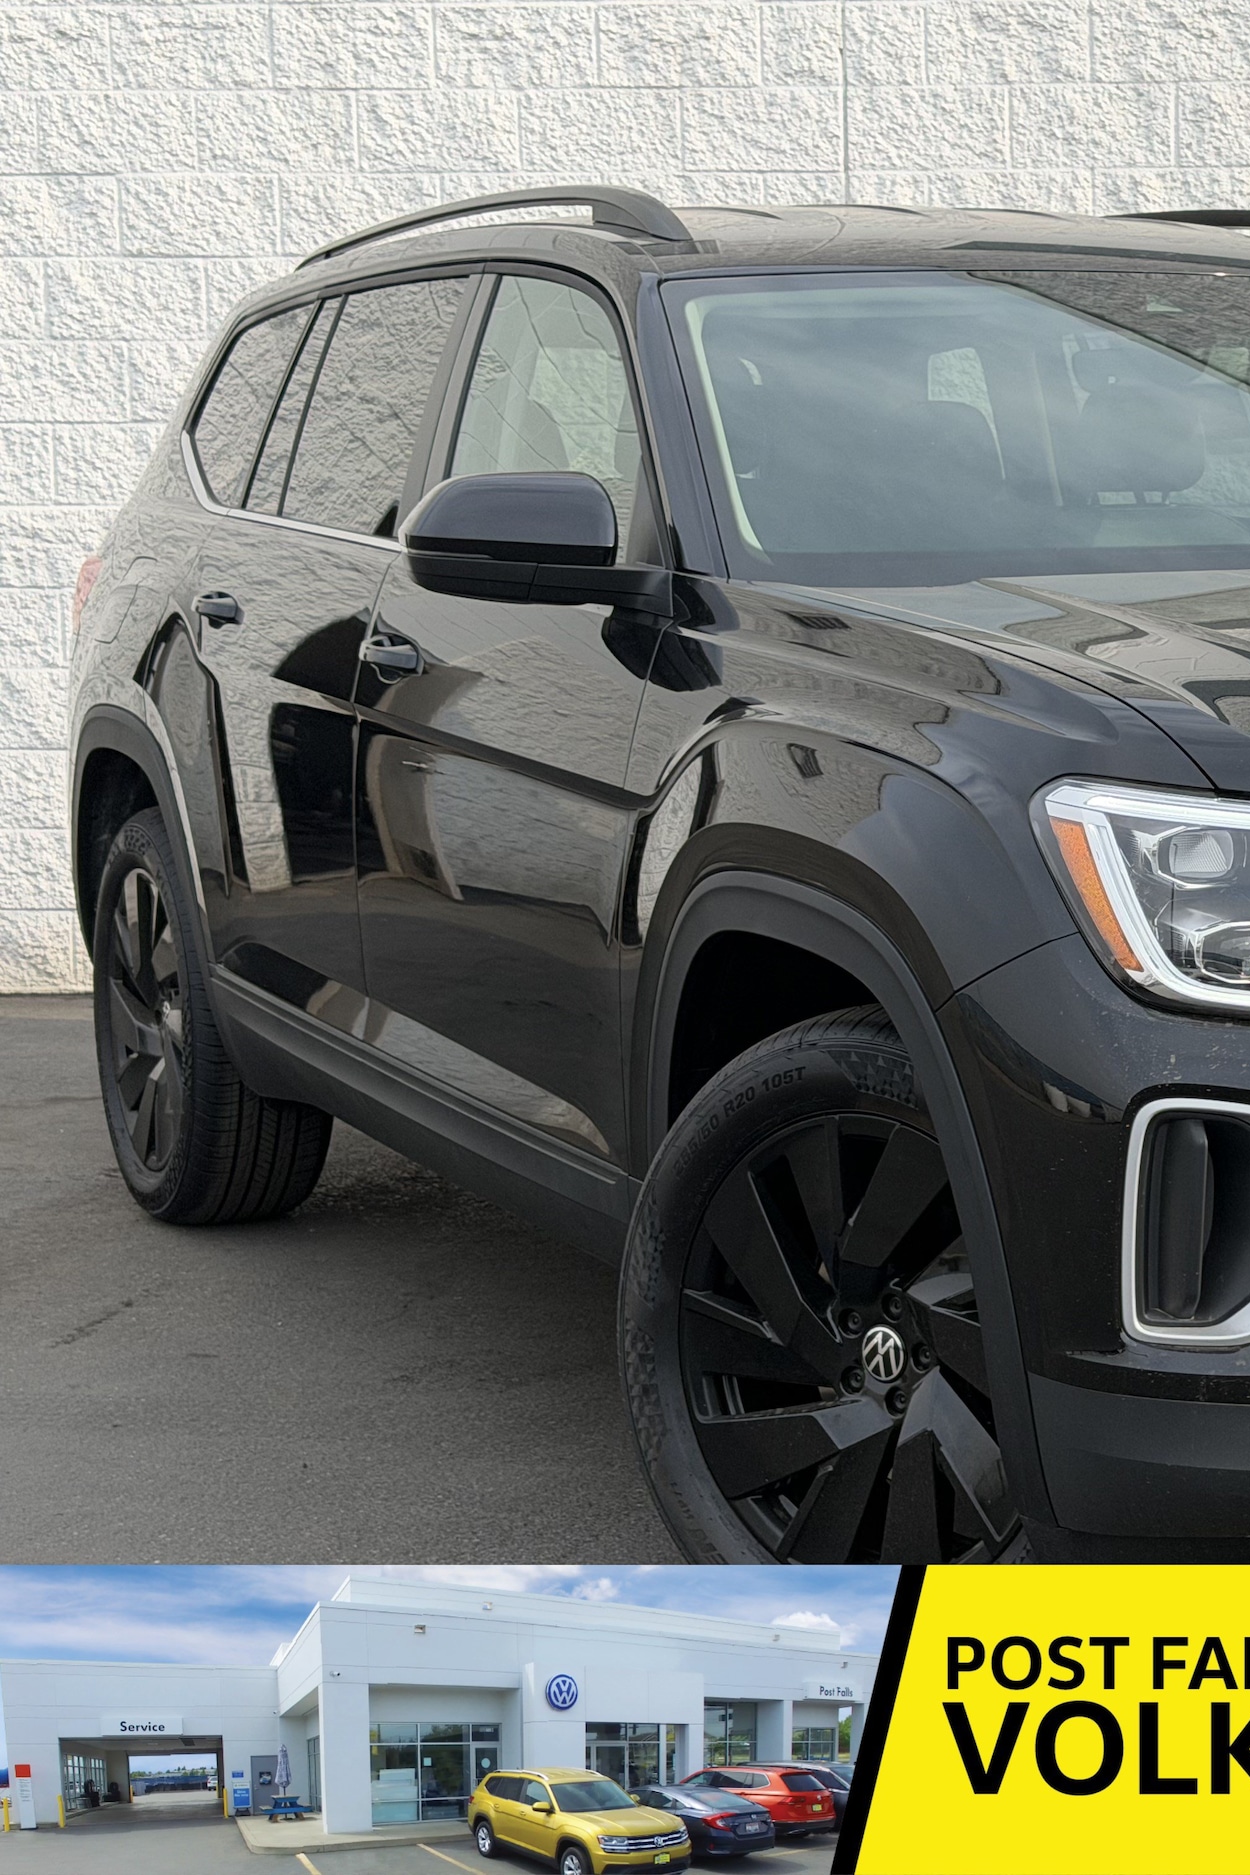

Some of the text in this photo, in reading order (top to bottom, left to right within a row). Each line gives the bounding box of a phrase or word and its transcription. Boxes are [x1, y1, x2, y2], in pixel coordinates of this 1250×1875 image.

[723, 1086, 756, 1119] R20
[761, 1066, 807, 1093] 105T
[819, 1686, 853, 1697] Post Falls
[120, 1721, 166, 1732] Service
